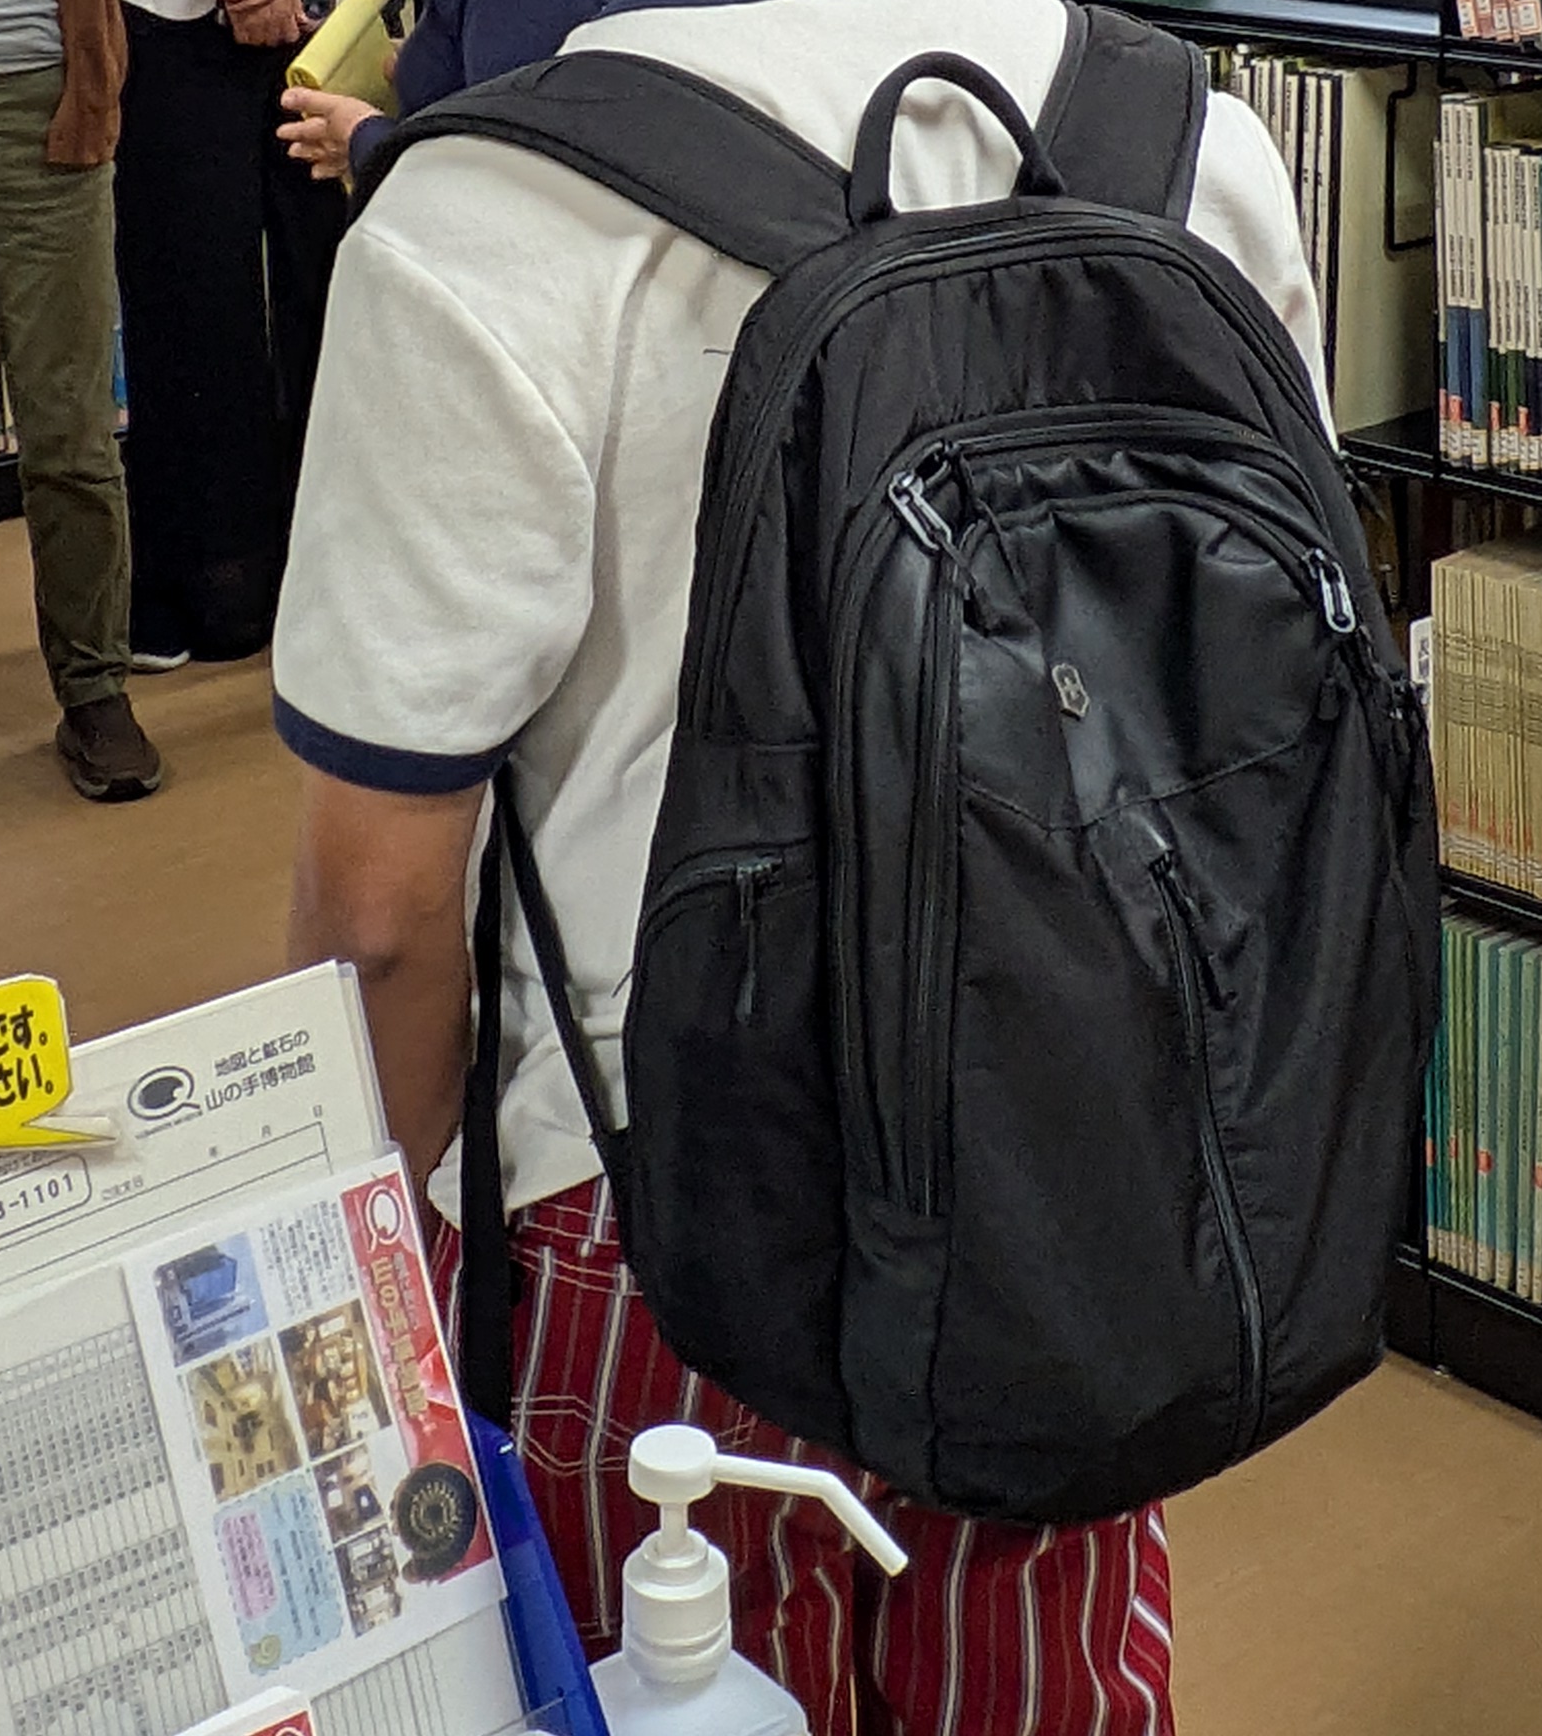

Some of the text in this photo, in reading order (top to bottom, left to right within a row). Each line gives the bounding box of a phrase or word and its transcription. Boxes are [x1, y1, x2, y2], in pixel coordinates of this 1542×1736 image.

[205, 1052, 316, 1112] 山の手博物館
